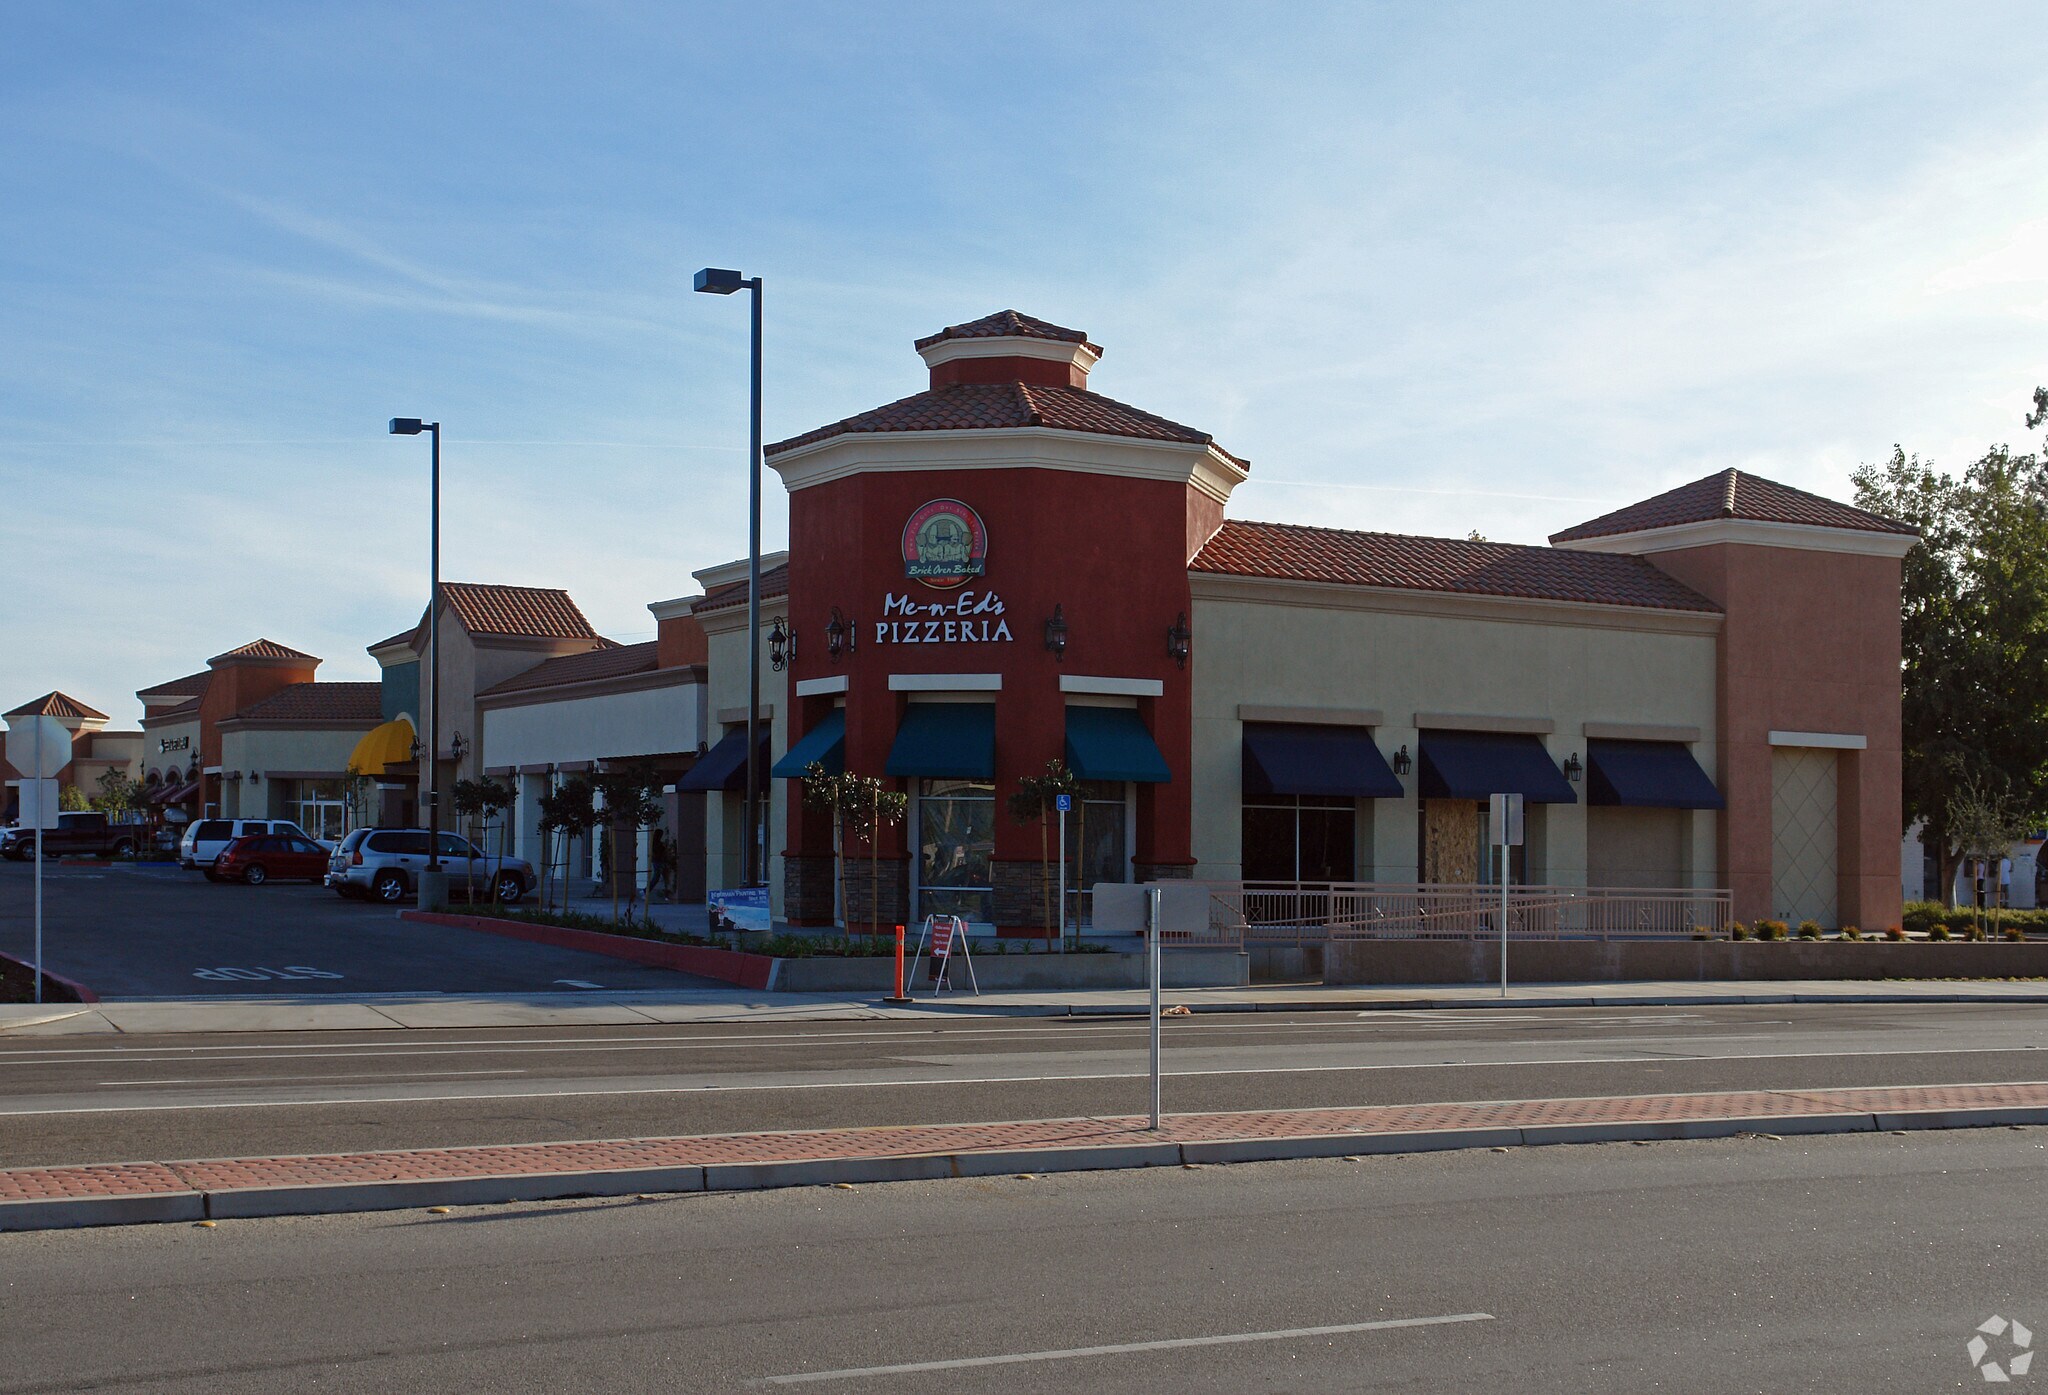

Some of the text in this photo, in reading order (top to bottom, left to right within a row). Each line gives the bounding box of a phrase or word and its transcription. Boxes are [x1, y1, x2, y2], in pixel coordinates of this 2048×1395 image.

[908, 565, 932, 574] Brick
[952, 564, 982, 573] Baked
[883, 591, 1005, 616] Me-n-Ed's
[875, 618, 1014, 643] PIZZERIA
[192, 965, 345, 981] STOP
